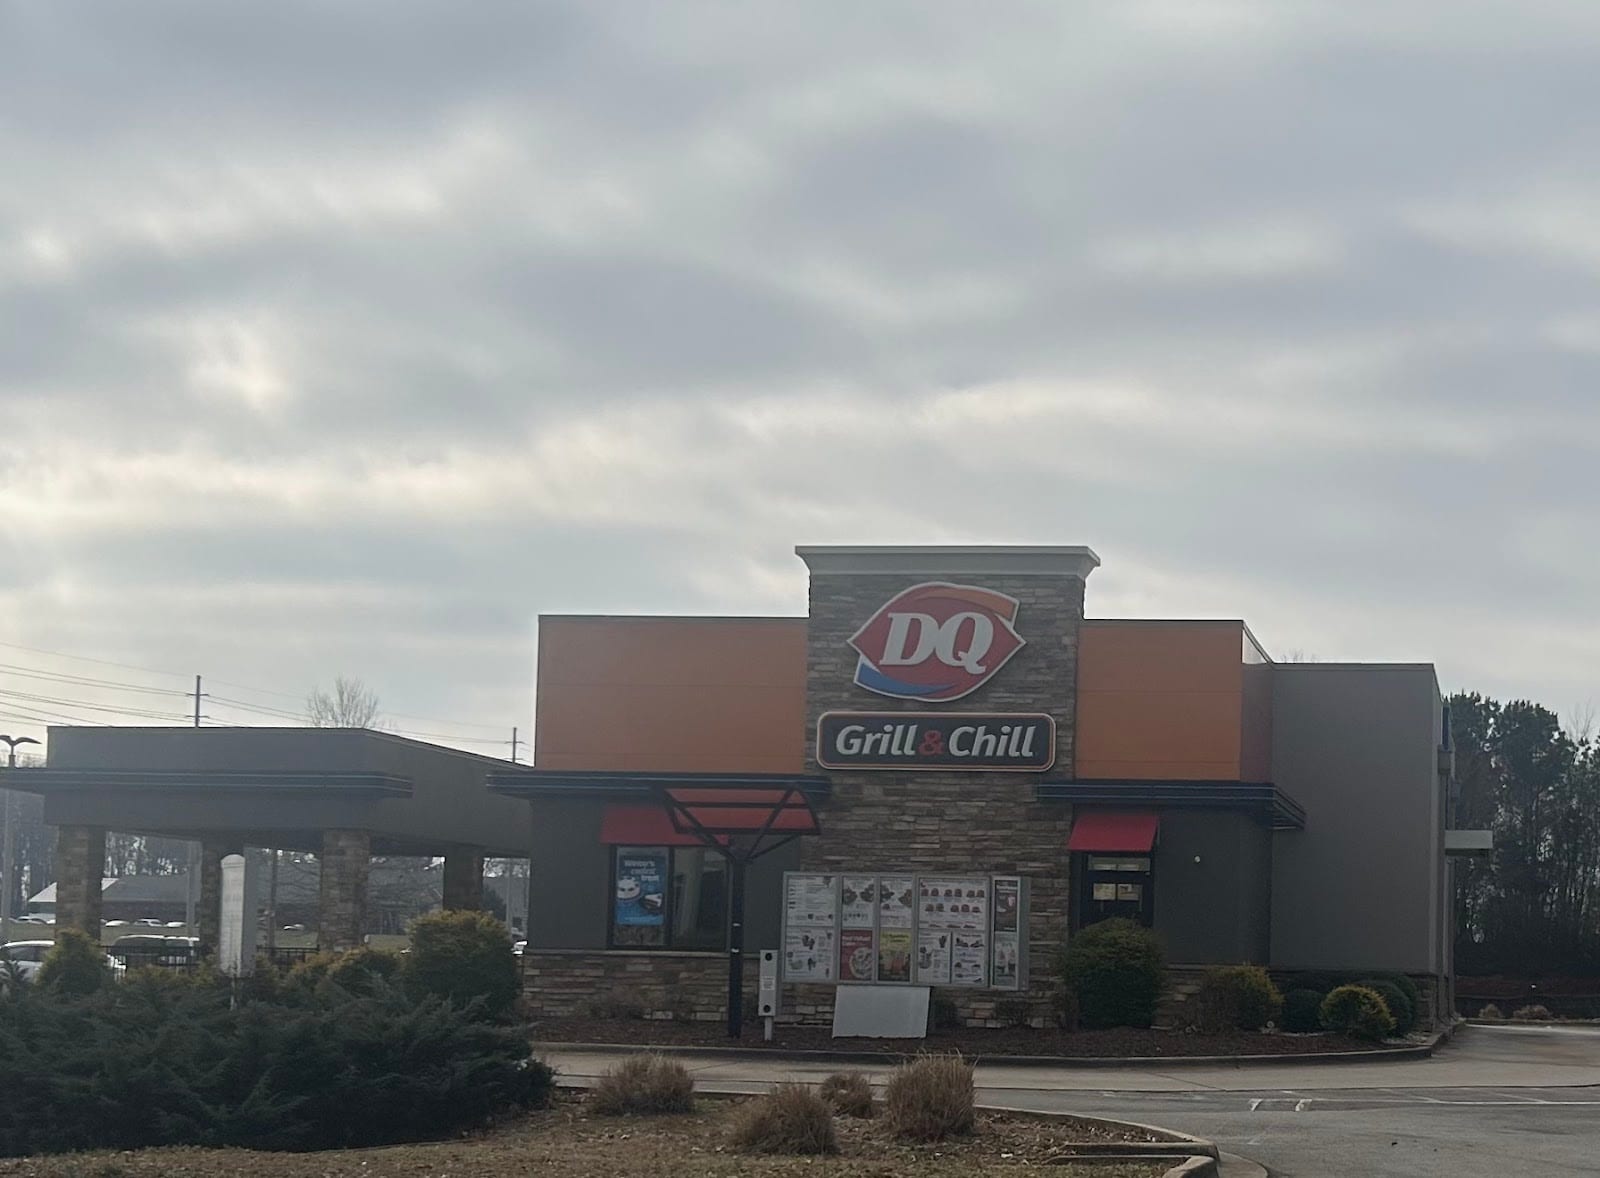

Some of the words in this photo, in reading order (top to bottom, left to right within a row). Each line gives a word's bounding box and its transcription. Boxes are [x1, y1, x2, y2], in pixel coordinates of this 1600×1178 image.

[879, 612, 994, 675] DQ
[836, 725, 918, 755] Grill
[919, 730, 944, 756] &
[948, 725, 1037, 757] Chill
